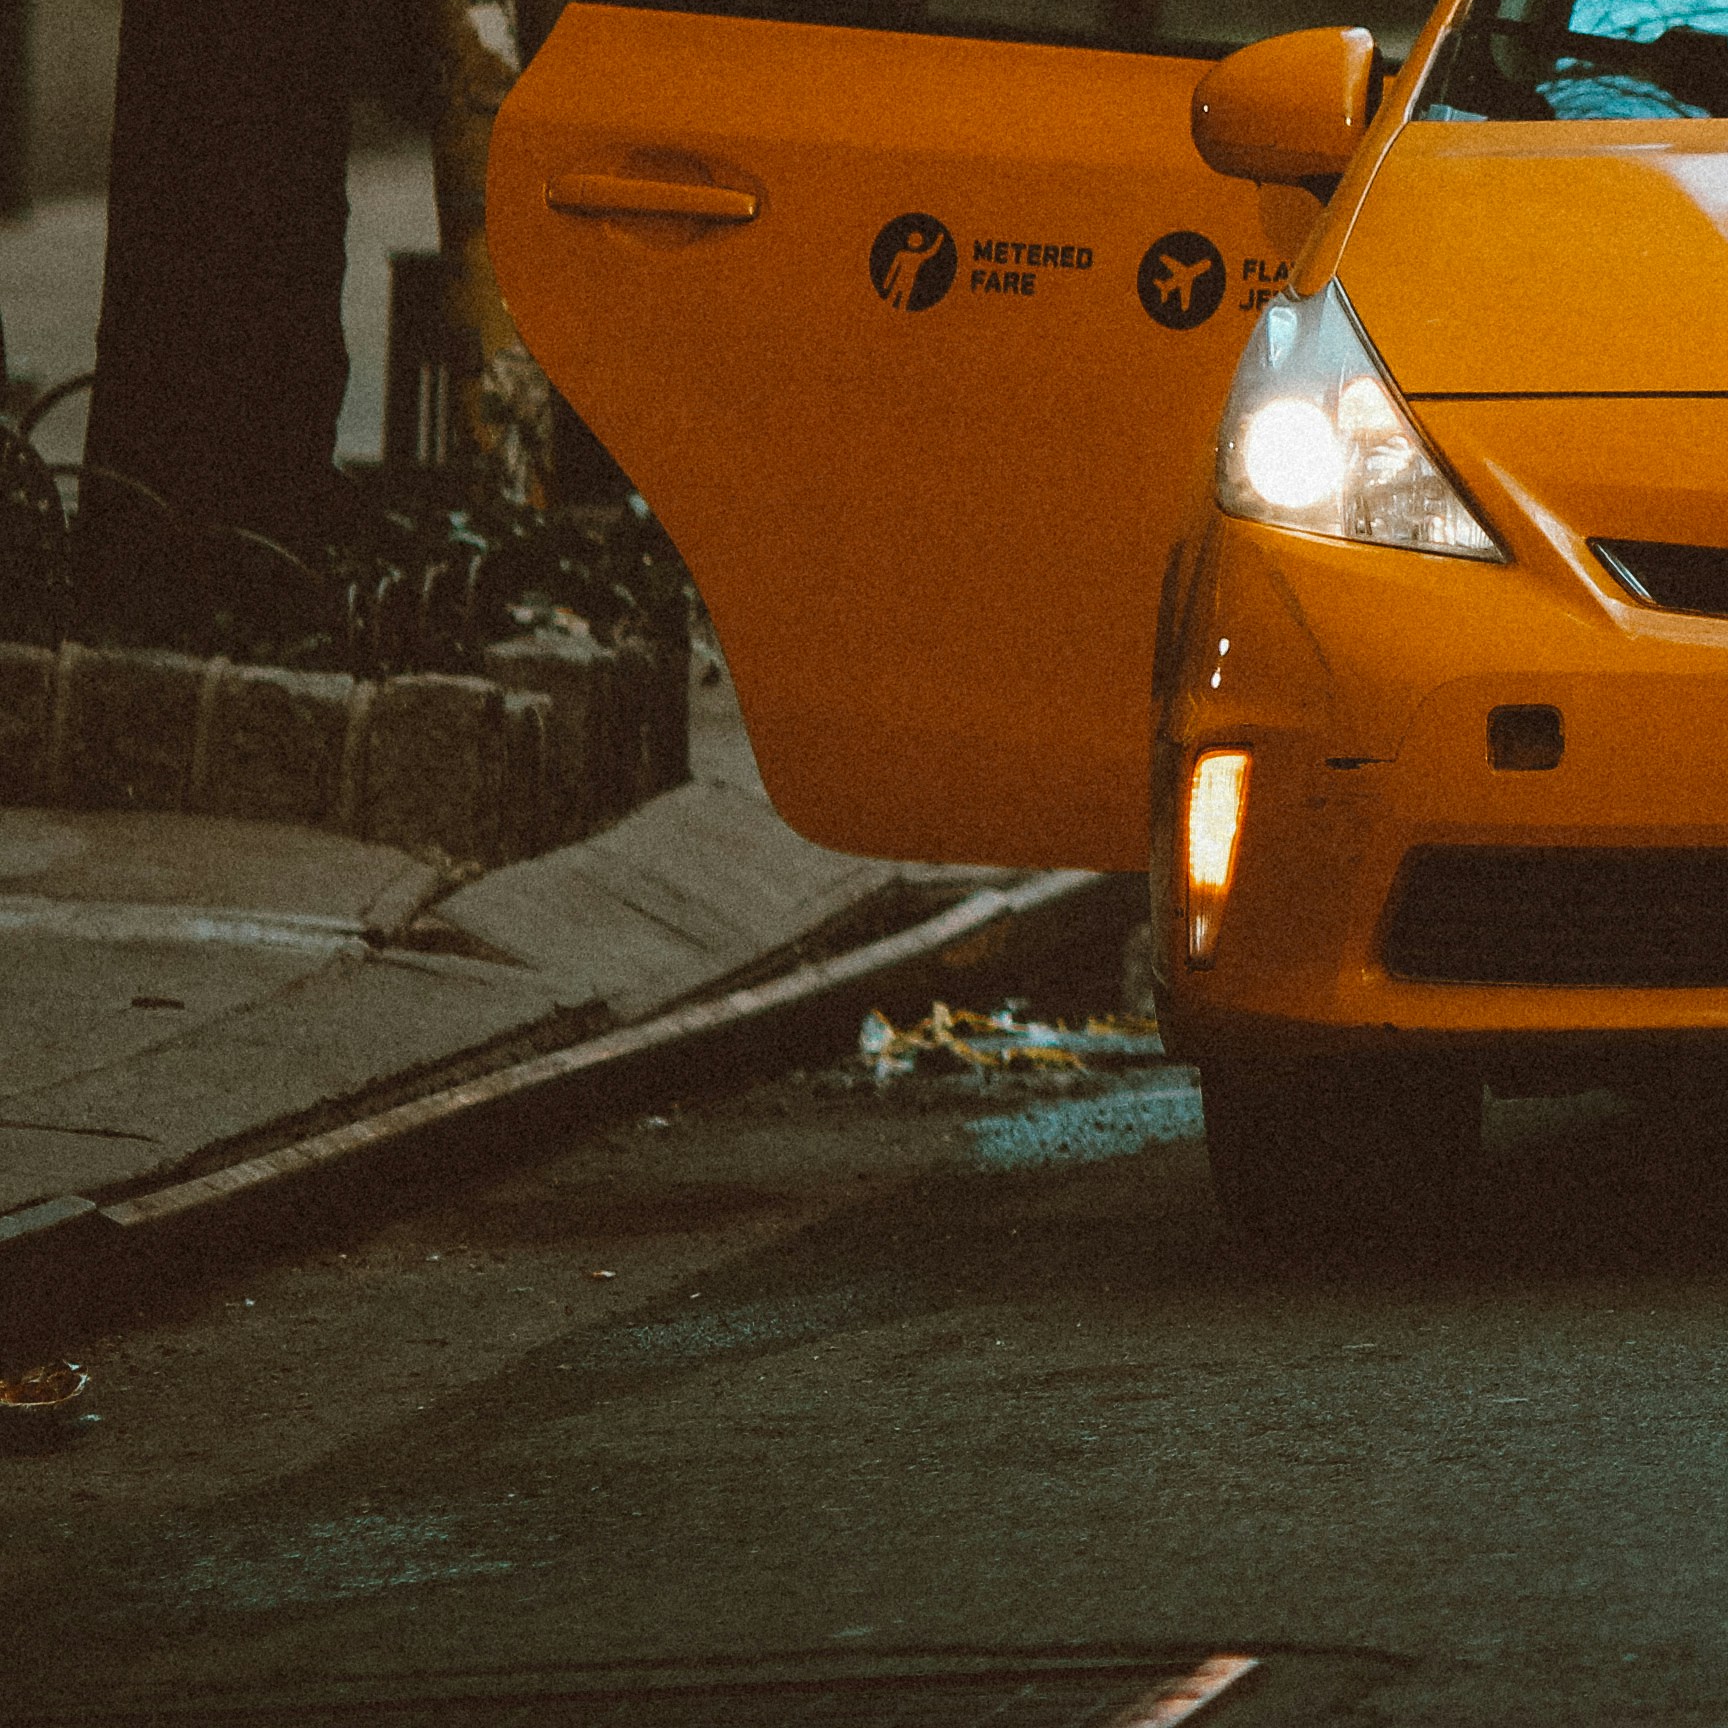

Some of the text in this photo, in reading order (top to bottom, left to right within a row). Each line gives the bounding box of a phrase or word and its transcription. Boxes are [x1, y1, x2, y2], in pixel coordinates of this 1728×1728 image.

[972, 239, 1094, 271] METERED
[1242, 258, 1296, 282] FLA
[970, 270, 1036, 297] FARE
[1239, 287, 1280, 311] JF
